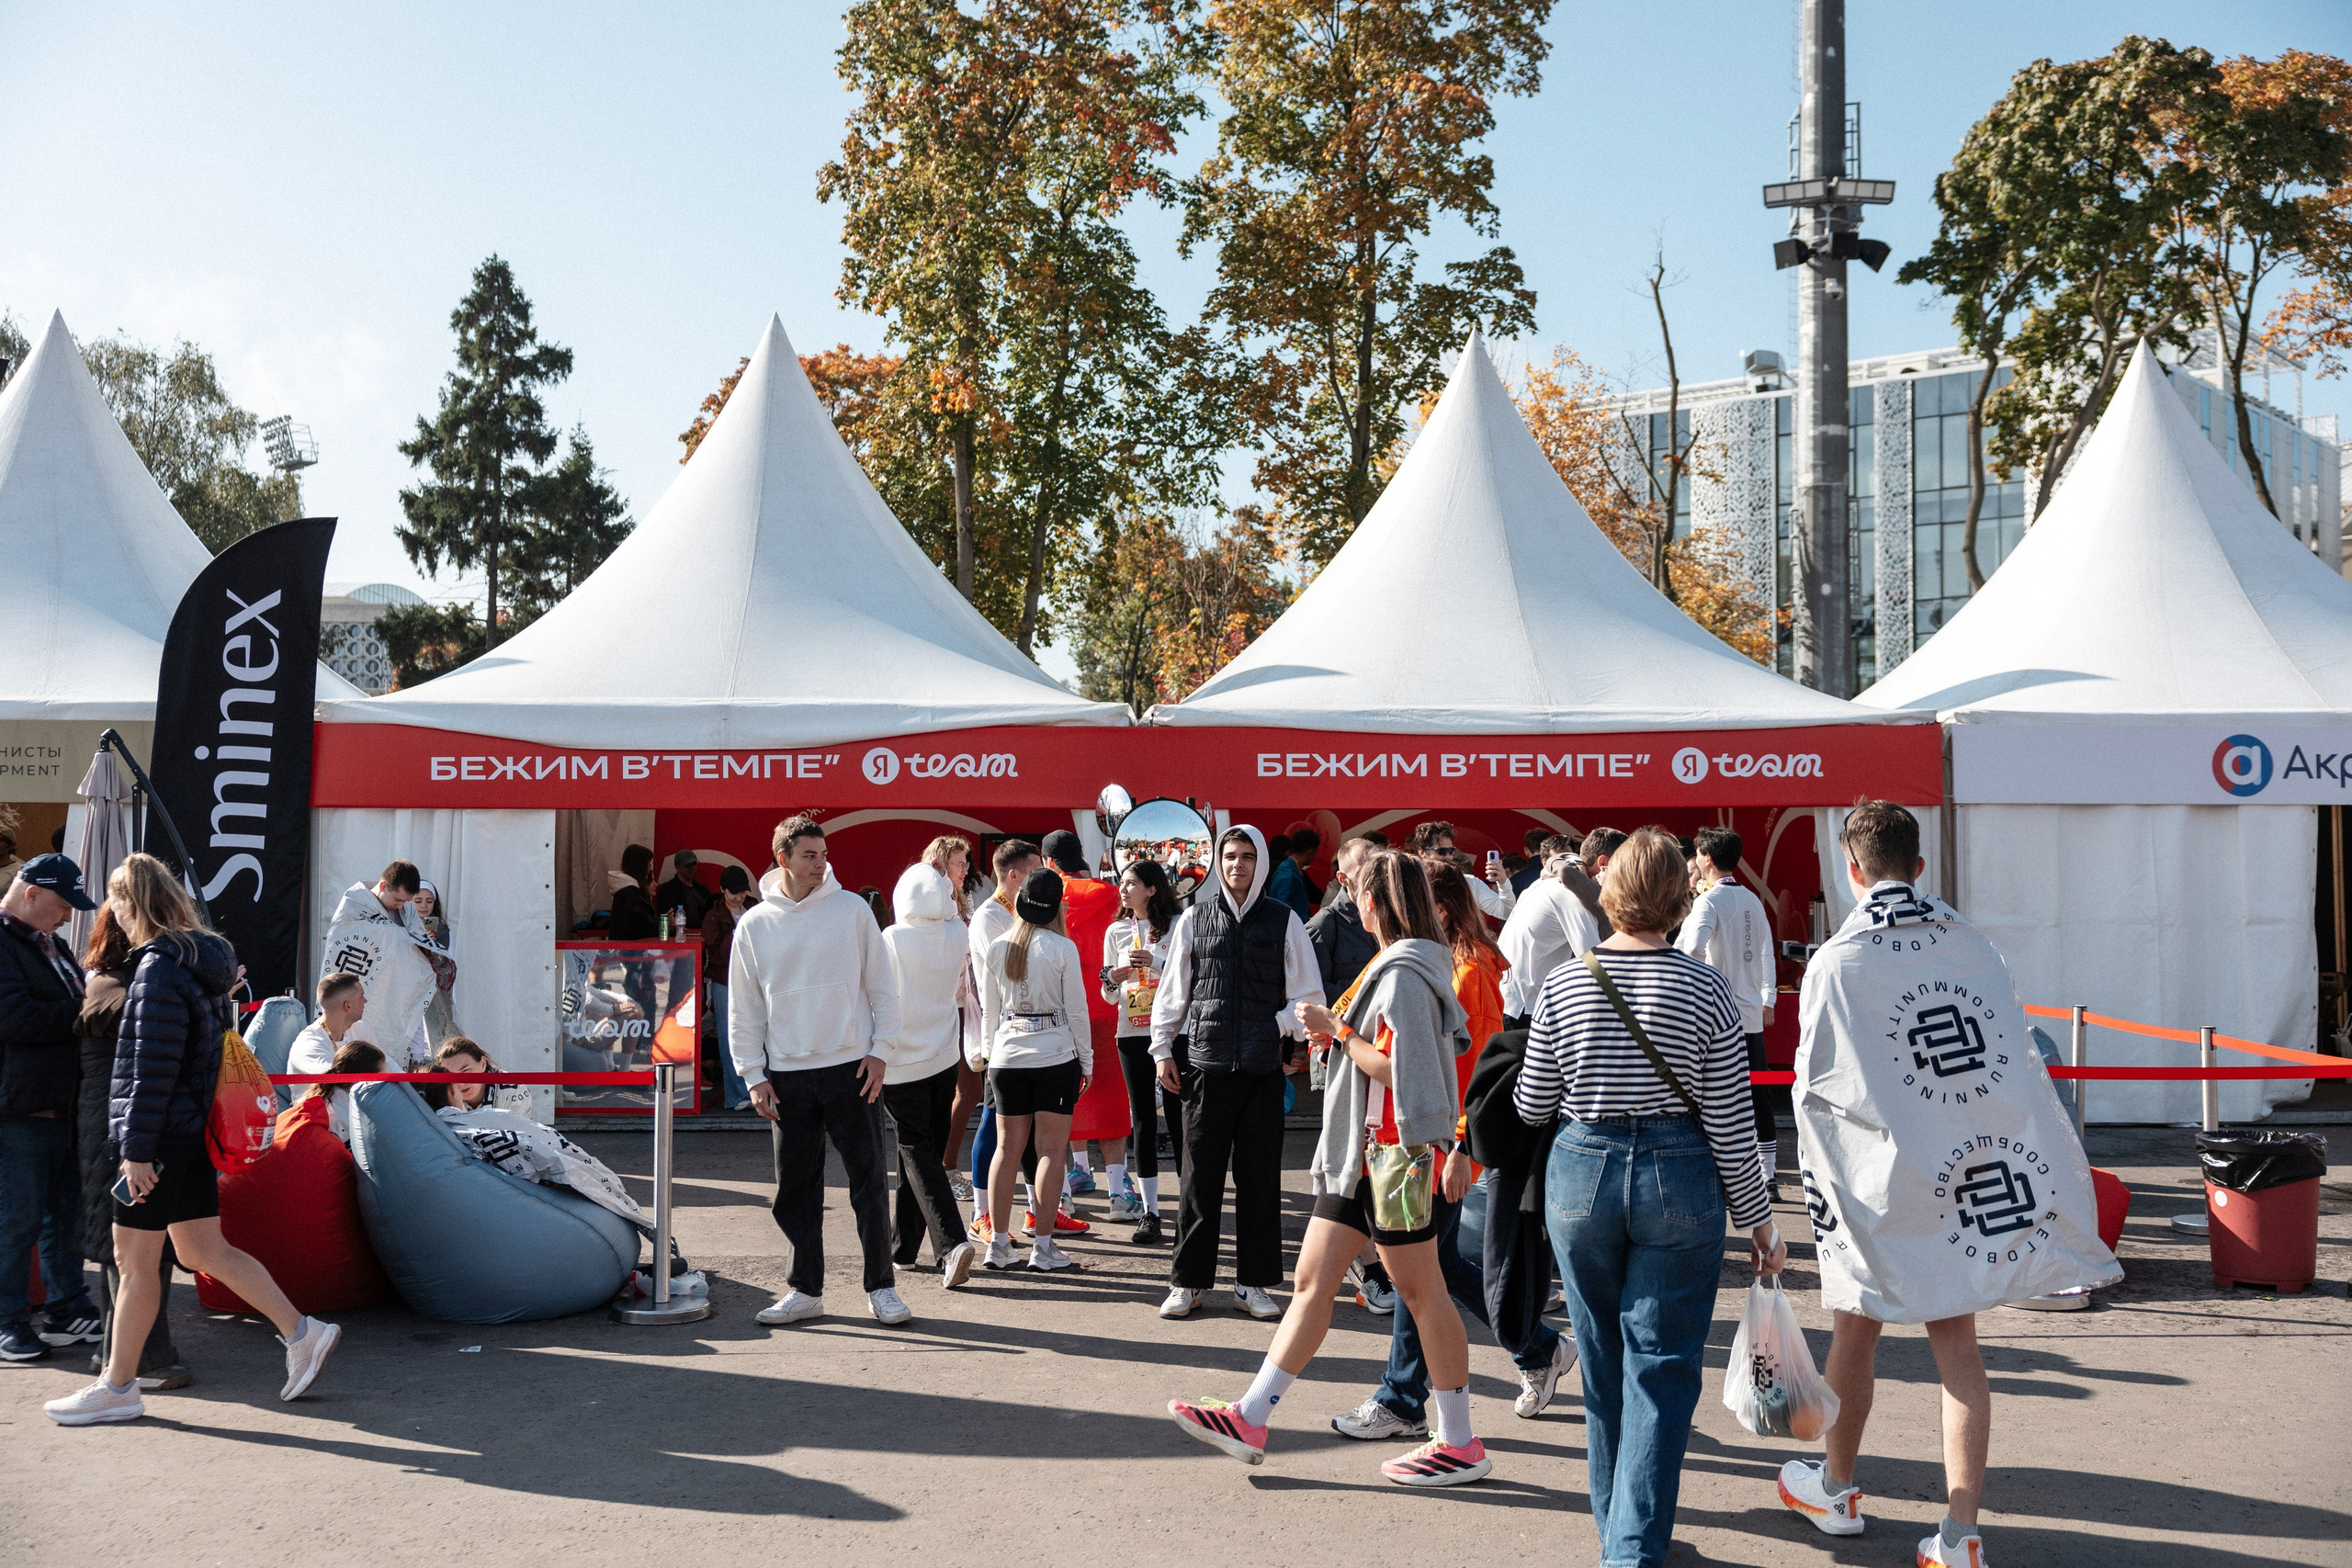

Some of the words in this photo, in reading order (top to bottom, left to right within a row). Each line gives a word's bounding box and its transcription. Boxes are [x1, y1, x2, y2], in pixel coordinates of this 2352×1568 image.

[430, 755, 609, 781] БЕЖИМ
[903, 752, 1019, 778] team
[1257, 752, 1428, 777] БЕЖИМ
[1712, 752, 1825, 778] team
[334, 934, 382, 962] RUNNING
[1341, 995, 1352, 1007] 10
[1886, 980, 1995, 1041] COMMUNITY
[563, 1018, 652, 1039] team
[1903, 1054, 2008, 1104] RUNNING
[1934, 1134, 2050, 1198] СООБЩЕСТВО
[1947, 1211, 2058, 1264] БЕГОВОЕ
